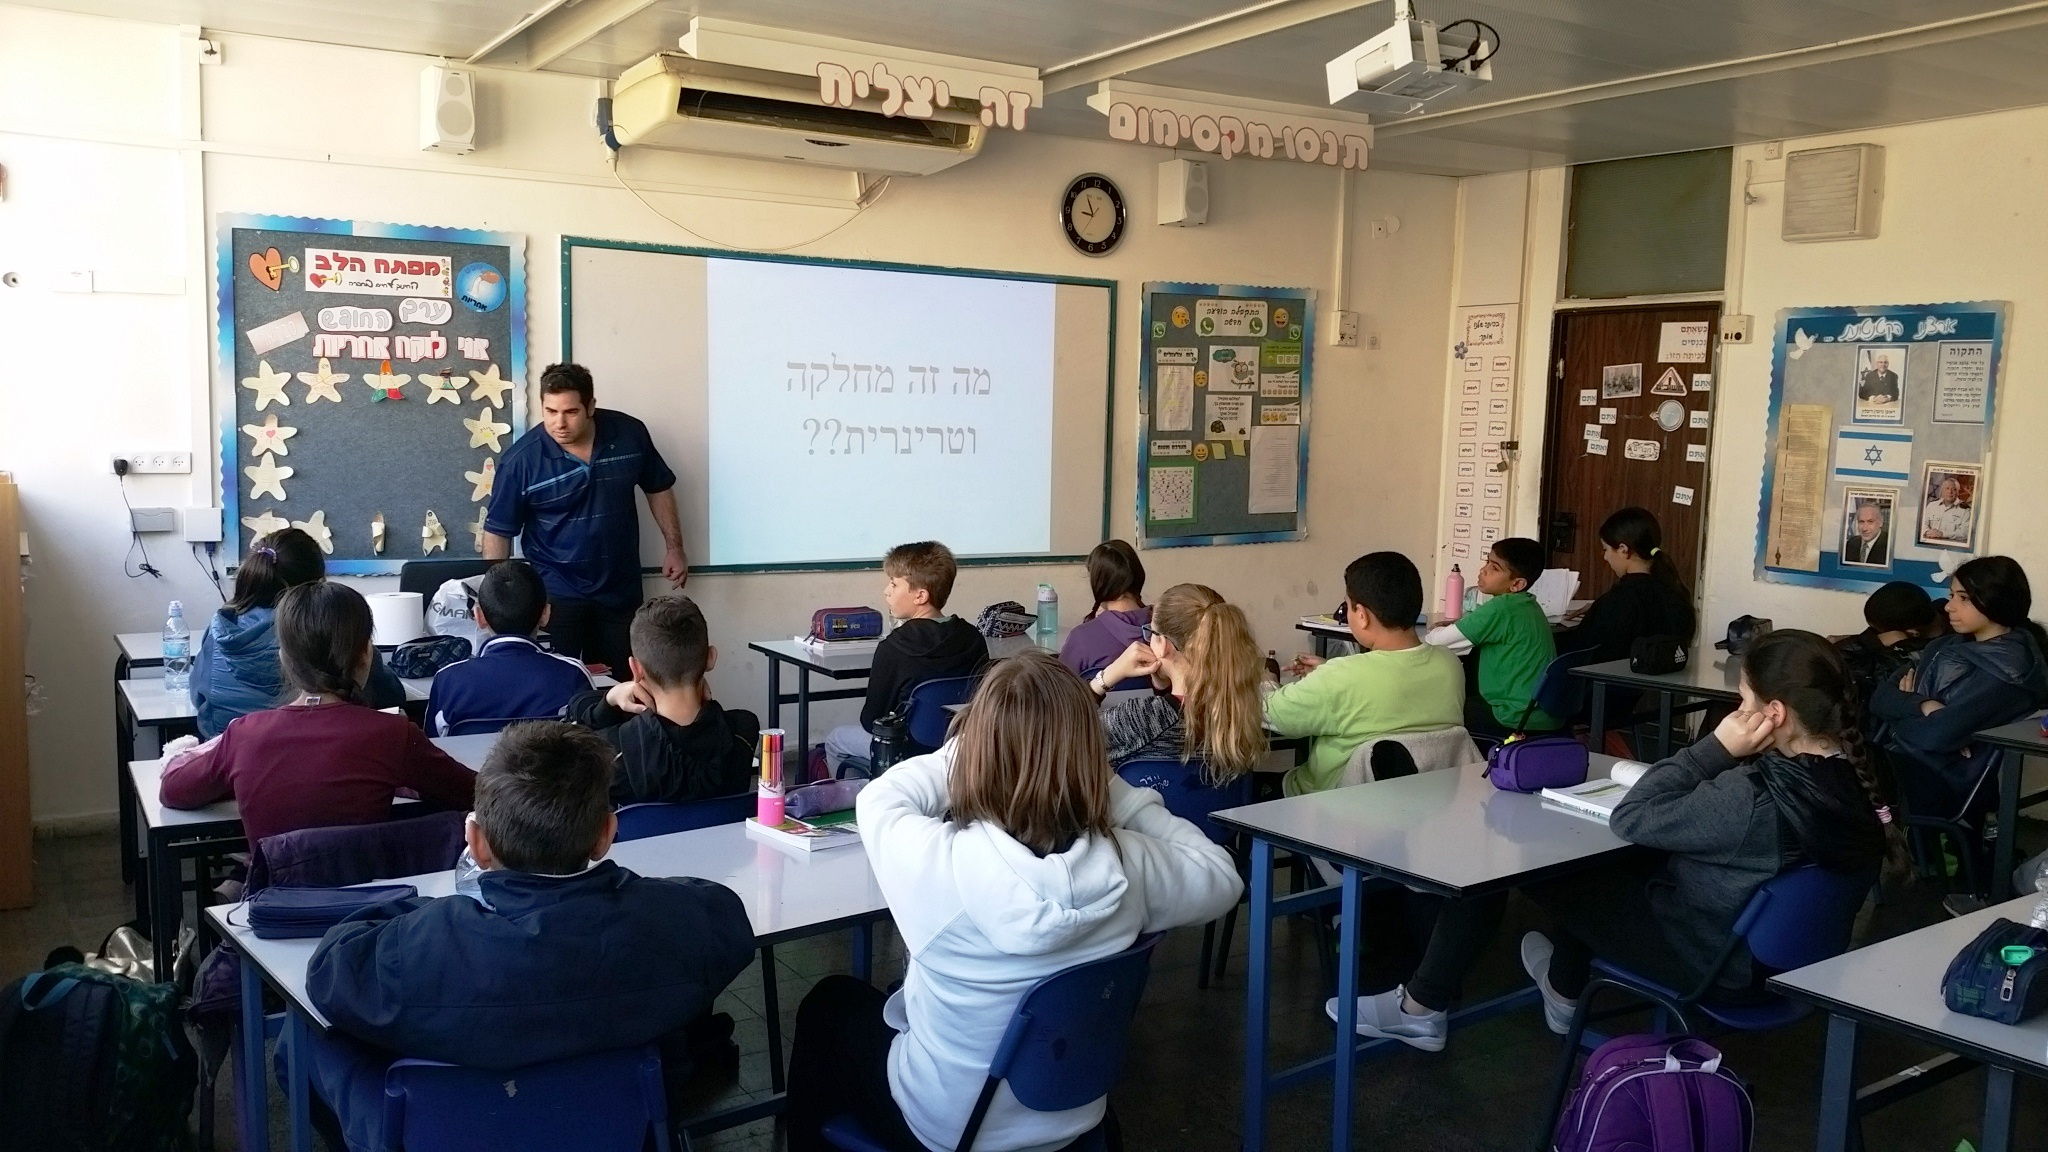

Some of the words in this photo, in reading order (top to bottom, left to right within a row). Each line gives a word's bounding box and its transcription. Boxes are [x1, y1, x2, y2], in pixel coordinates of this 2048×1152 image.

[816, 61, 950, 118] יצליח
[979, 86, 1032, 131] זה
[1108, 102, 1274, 161] מקסימום
[1281, 125, 1369, 171] תנסו
[315, 252, 366, 273] הלב
[374, 258, 441, 277] מפתח
[402, 300, 447, 323] ערך
[461, 294, 488, 312] אחריות
[321, 308, 390, 330] החודש
[312, 334, 392, 360] אחריות
[457, 336, 490, 361] אני
[1949, 347, 1983, 357] התקוה
[786, 351, 895, 401] מחלקה
[907, 364, 941, 395] זה
[952, 365, 992, 396] מה
[1694, 380, 1711, 388] אתם
[1581, 395, 1597, 403] אתם
[1601, 413, 1616, 421] אתם
[1692, 417, 1708, 425] אתם
[802, 417, 977, 456] וטרינרית??
[1586, 429, 1601, 438] אתם
[1688, 450, 1705, 458] אתם
[1675, 492, 1692, 502] אתם
